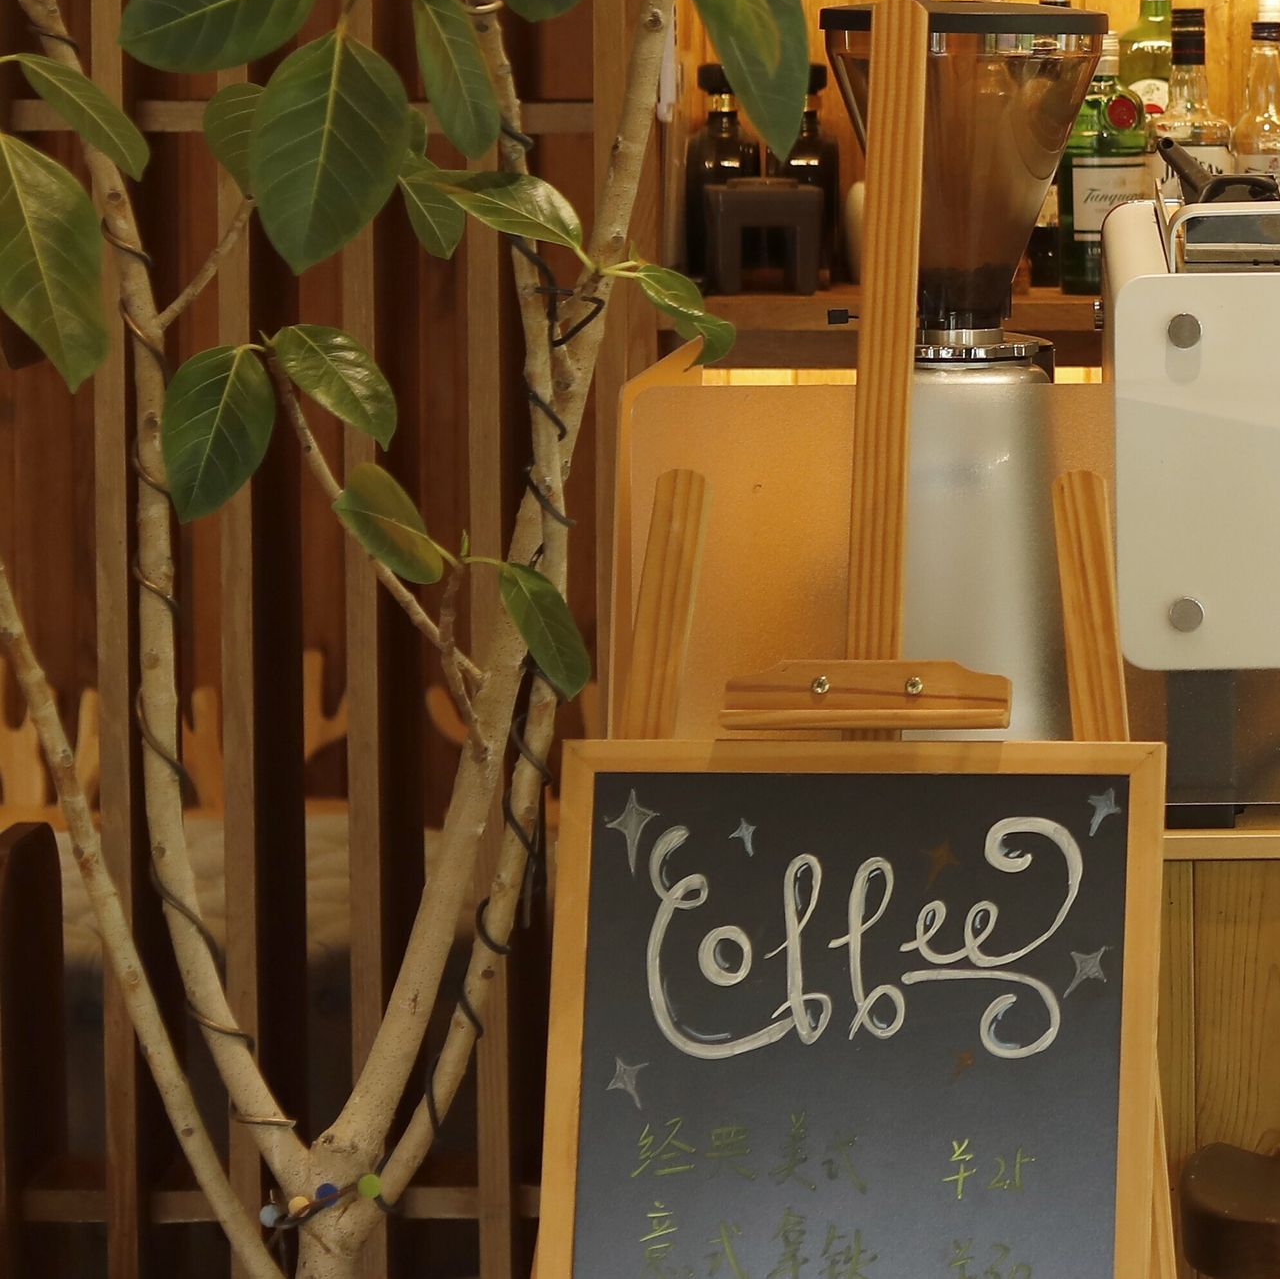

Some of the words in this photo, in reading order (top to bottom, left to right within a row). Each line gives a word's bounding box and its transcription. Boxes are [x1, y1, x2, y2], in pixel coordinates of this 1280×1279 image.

[647, 817, 1083, 1059] Coffee
[631, 1112, 868, 1195] 经典美式
